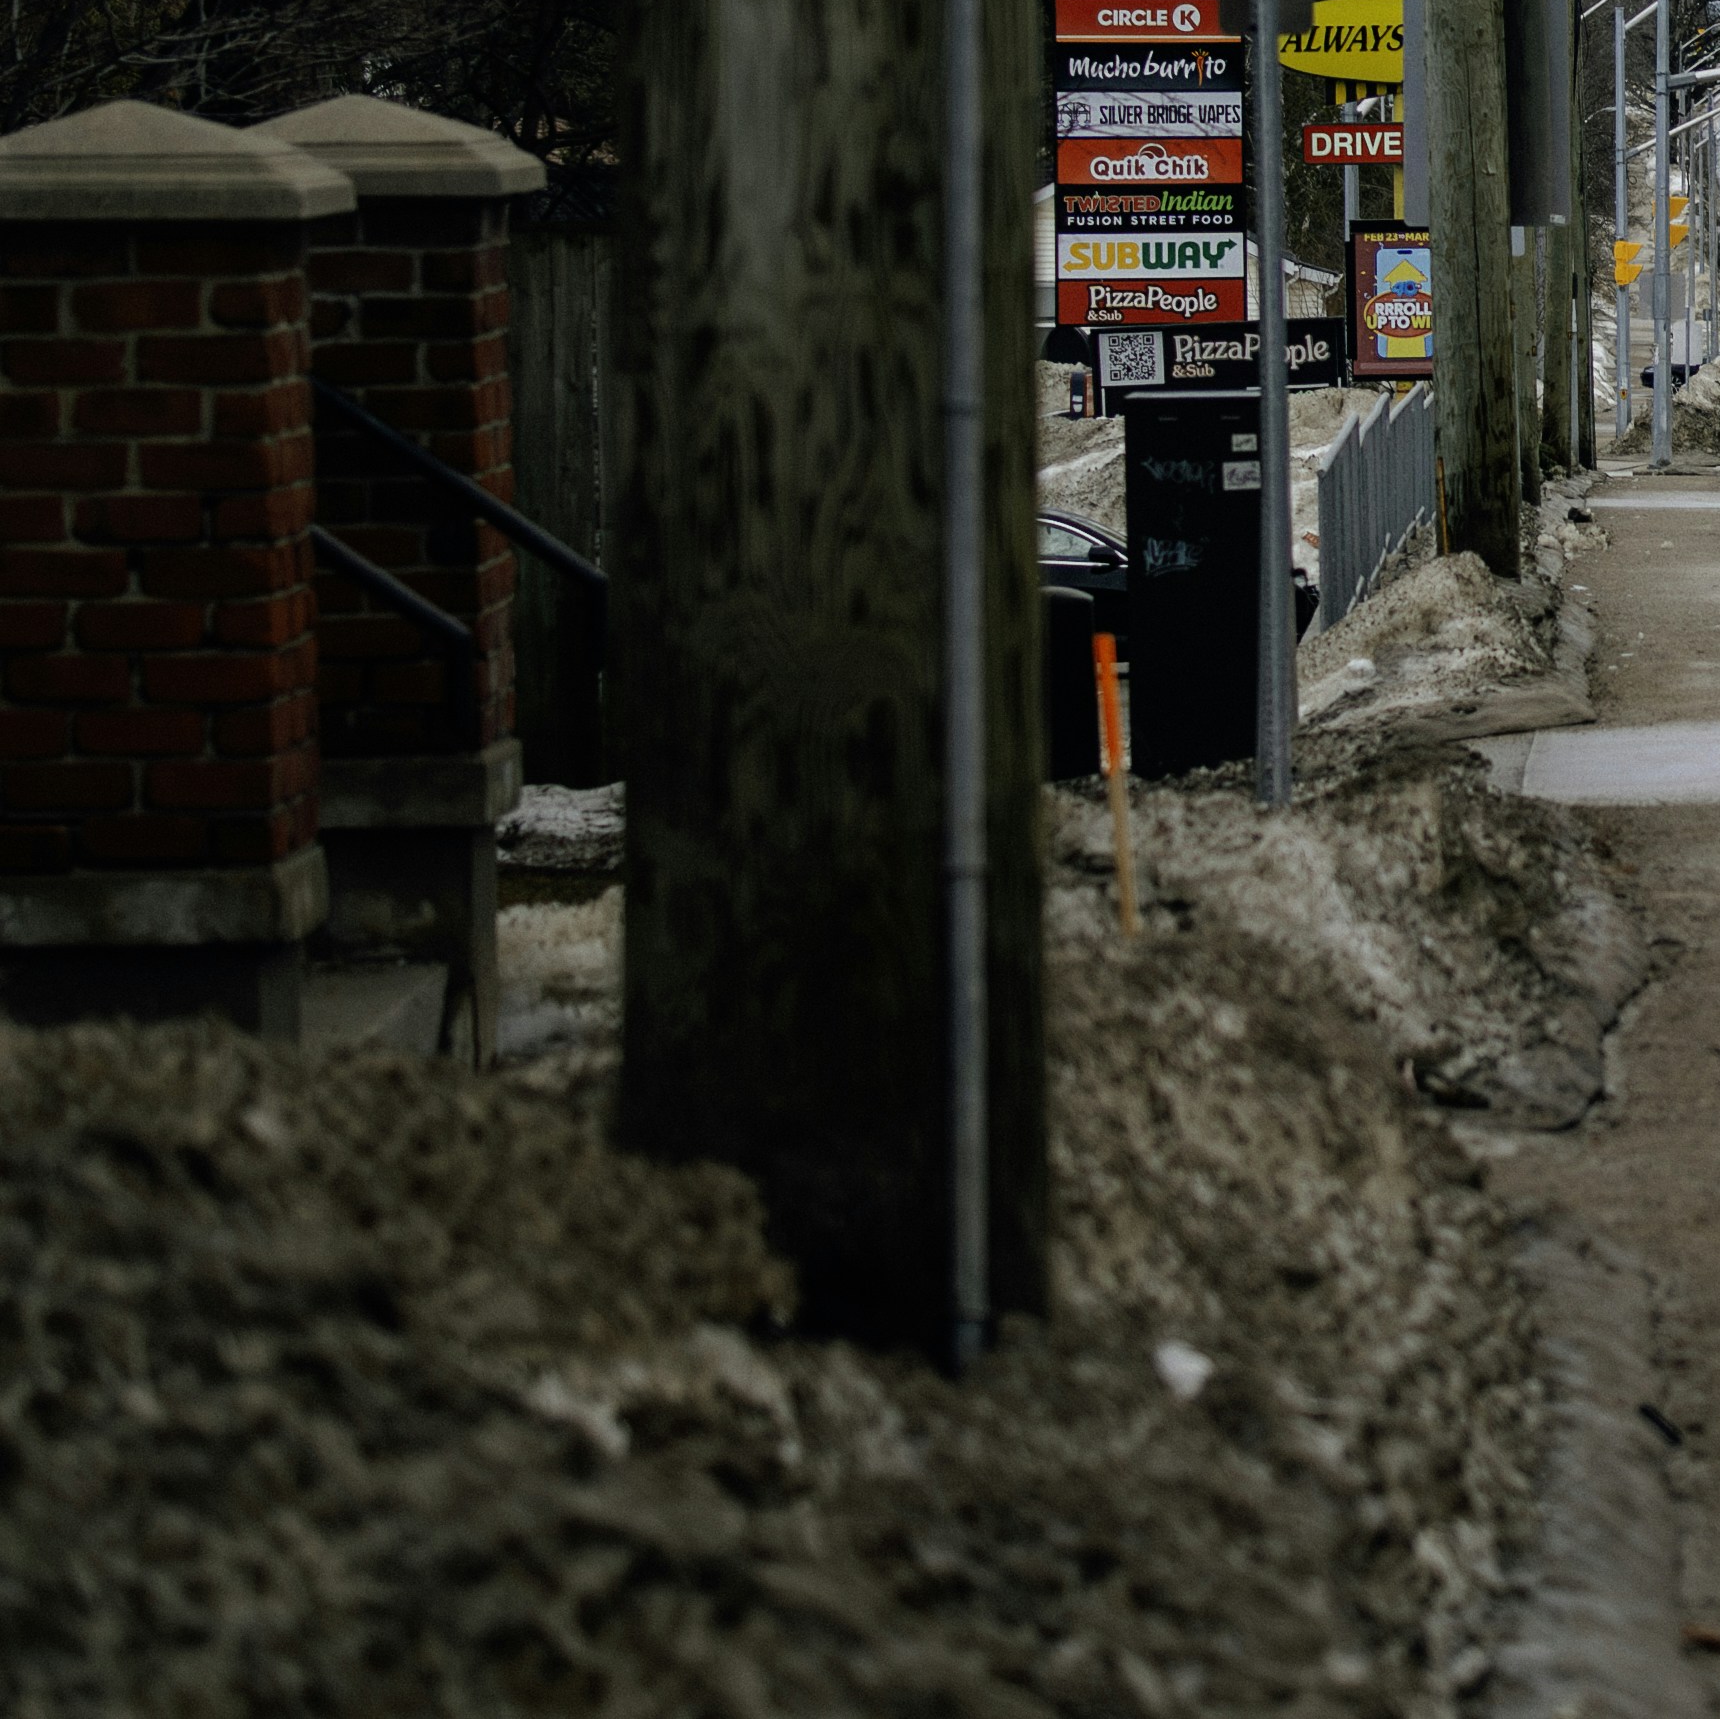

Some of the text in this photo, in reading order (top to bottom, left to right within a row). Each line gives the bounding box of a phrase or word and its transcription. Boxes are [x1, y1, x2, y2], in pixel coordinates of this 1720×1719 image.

[1097, 9, 1168, 27] CIRCLE
[1100, 104, 1241, 124] SILVER BRIDGE VAPES
[1311, 132, 1402, 156] DRIVE
[1093, 158, 1207, 176] Quik Chik
[1067, 214, 1233, 226] FUSION STREET FOOD
[1364, 233, 1384, 241] FEB
[1386, 233, 1398, 241] 23
[1405, 233, 1429, 241] MAR
[1063, 238, 1237, 273] SUBWAY
[1375, 302, 1432, 316] RRROLL
